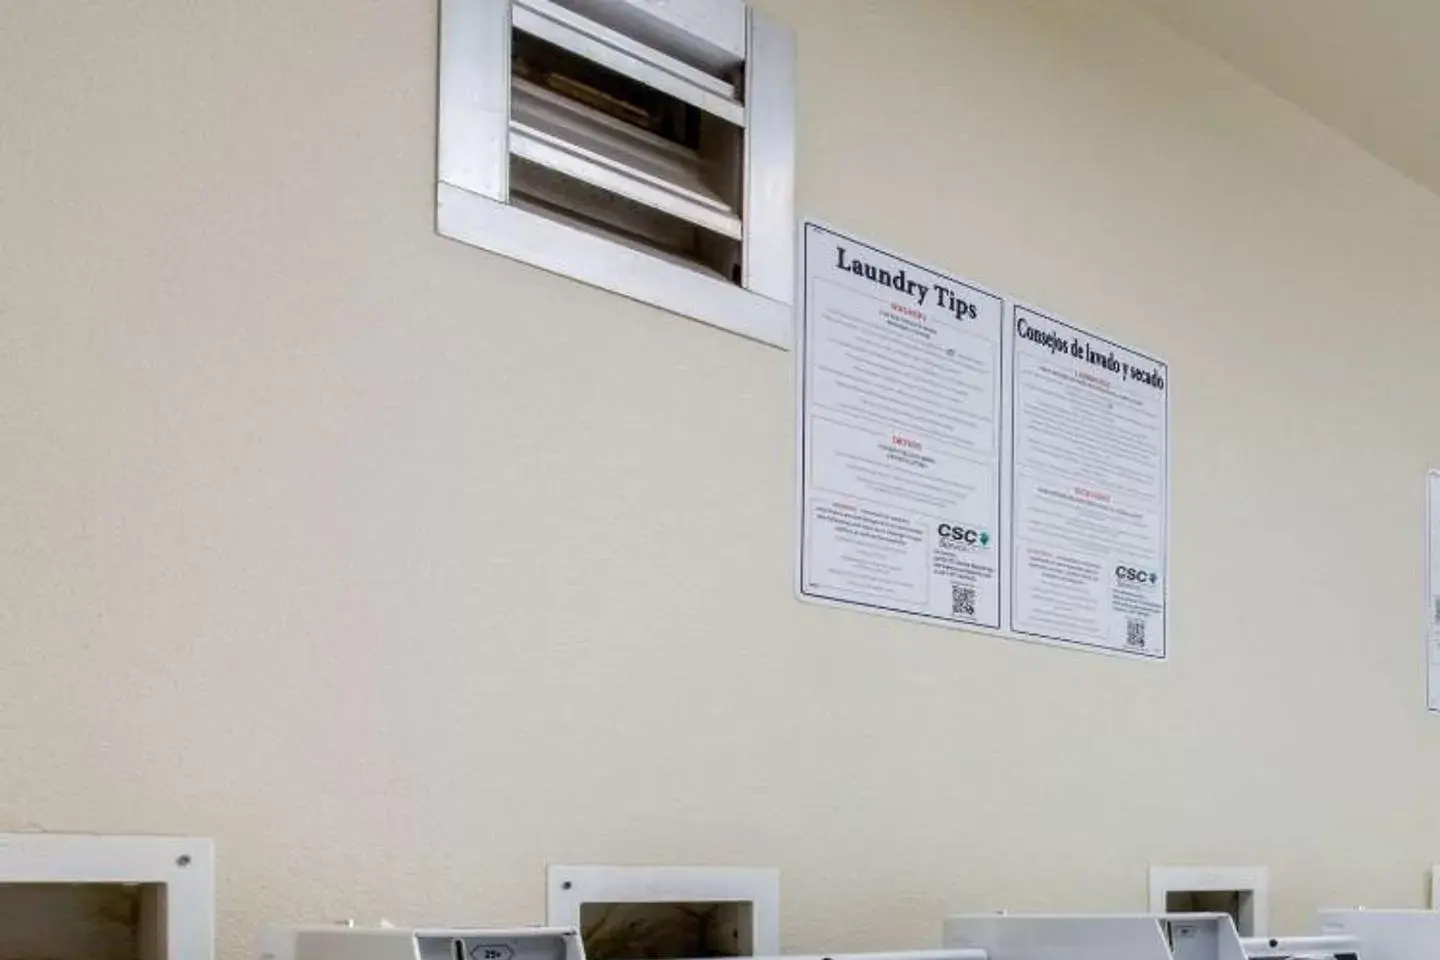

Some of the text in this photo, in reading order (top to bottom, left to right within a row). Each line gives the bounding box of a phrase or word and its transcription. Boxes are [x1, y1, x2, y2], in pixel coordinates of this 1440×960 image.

[836, 246, 978, 321] Laundry Tips
[1016, 318, 1068, 354] Consejos
[1071, 338, 1084, 360] de
[1086, 343, 1120, 373] lavado
[1122, 363, 1130, 381] y
[1131, 367, 1165, 390] secado
[938, 523, 977, 545] CSC
[1115, 565, 1148, 583] CSC
